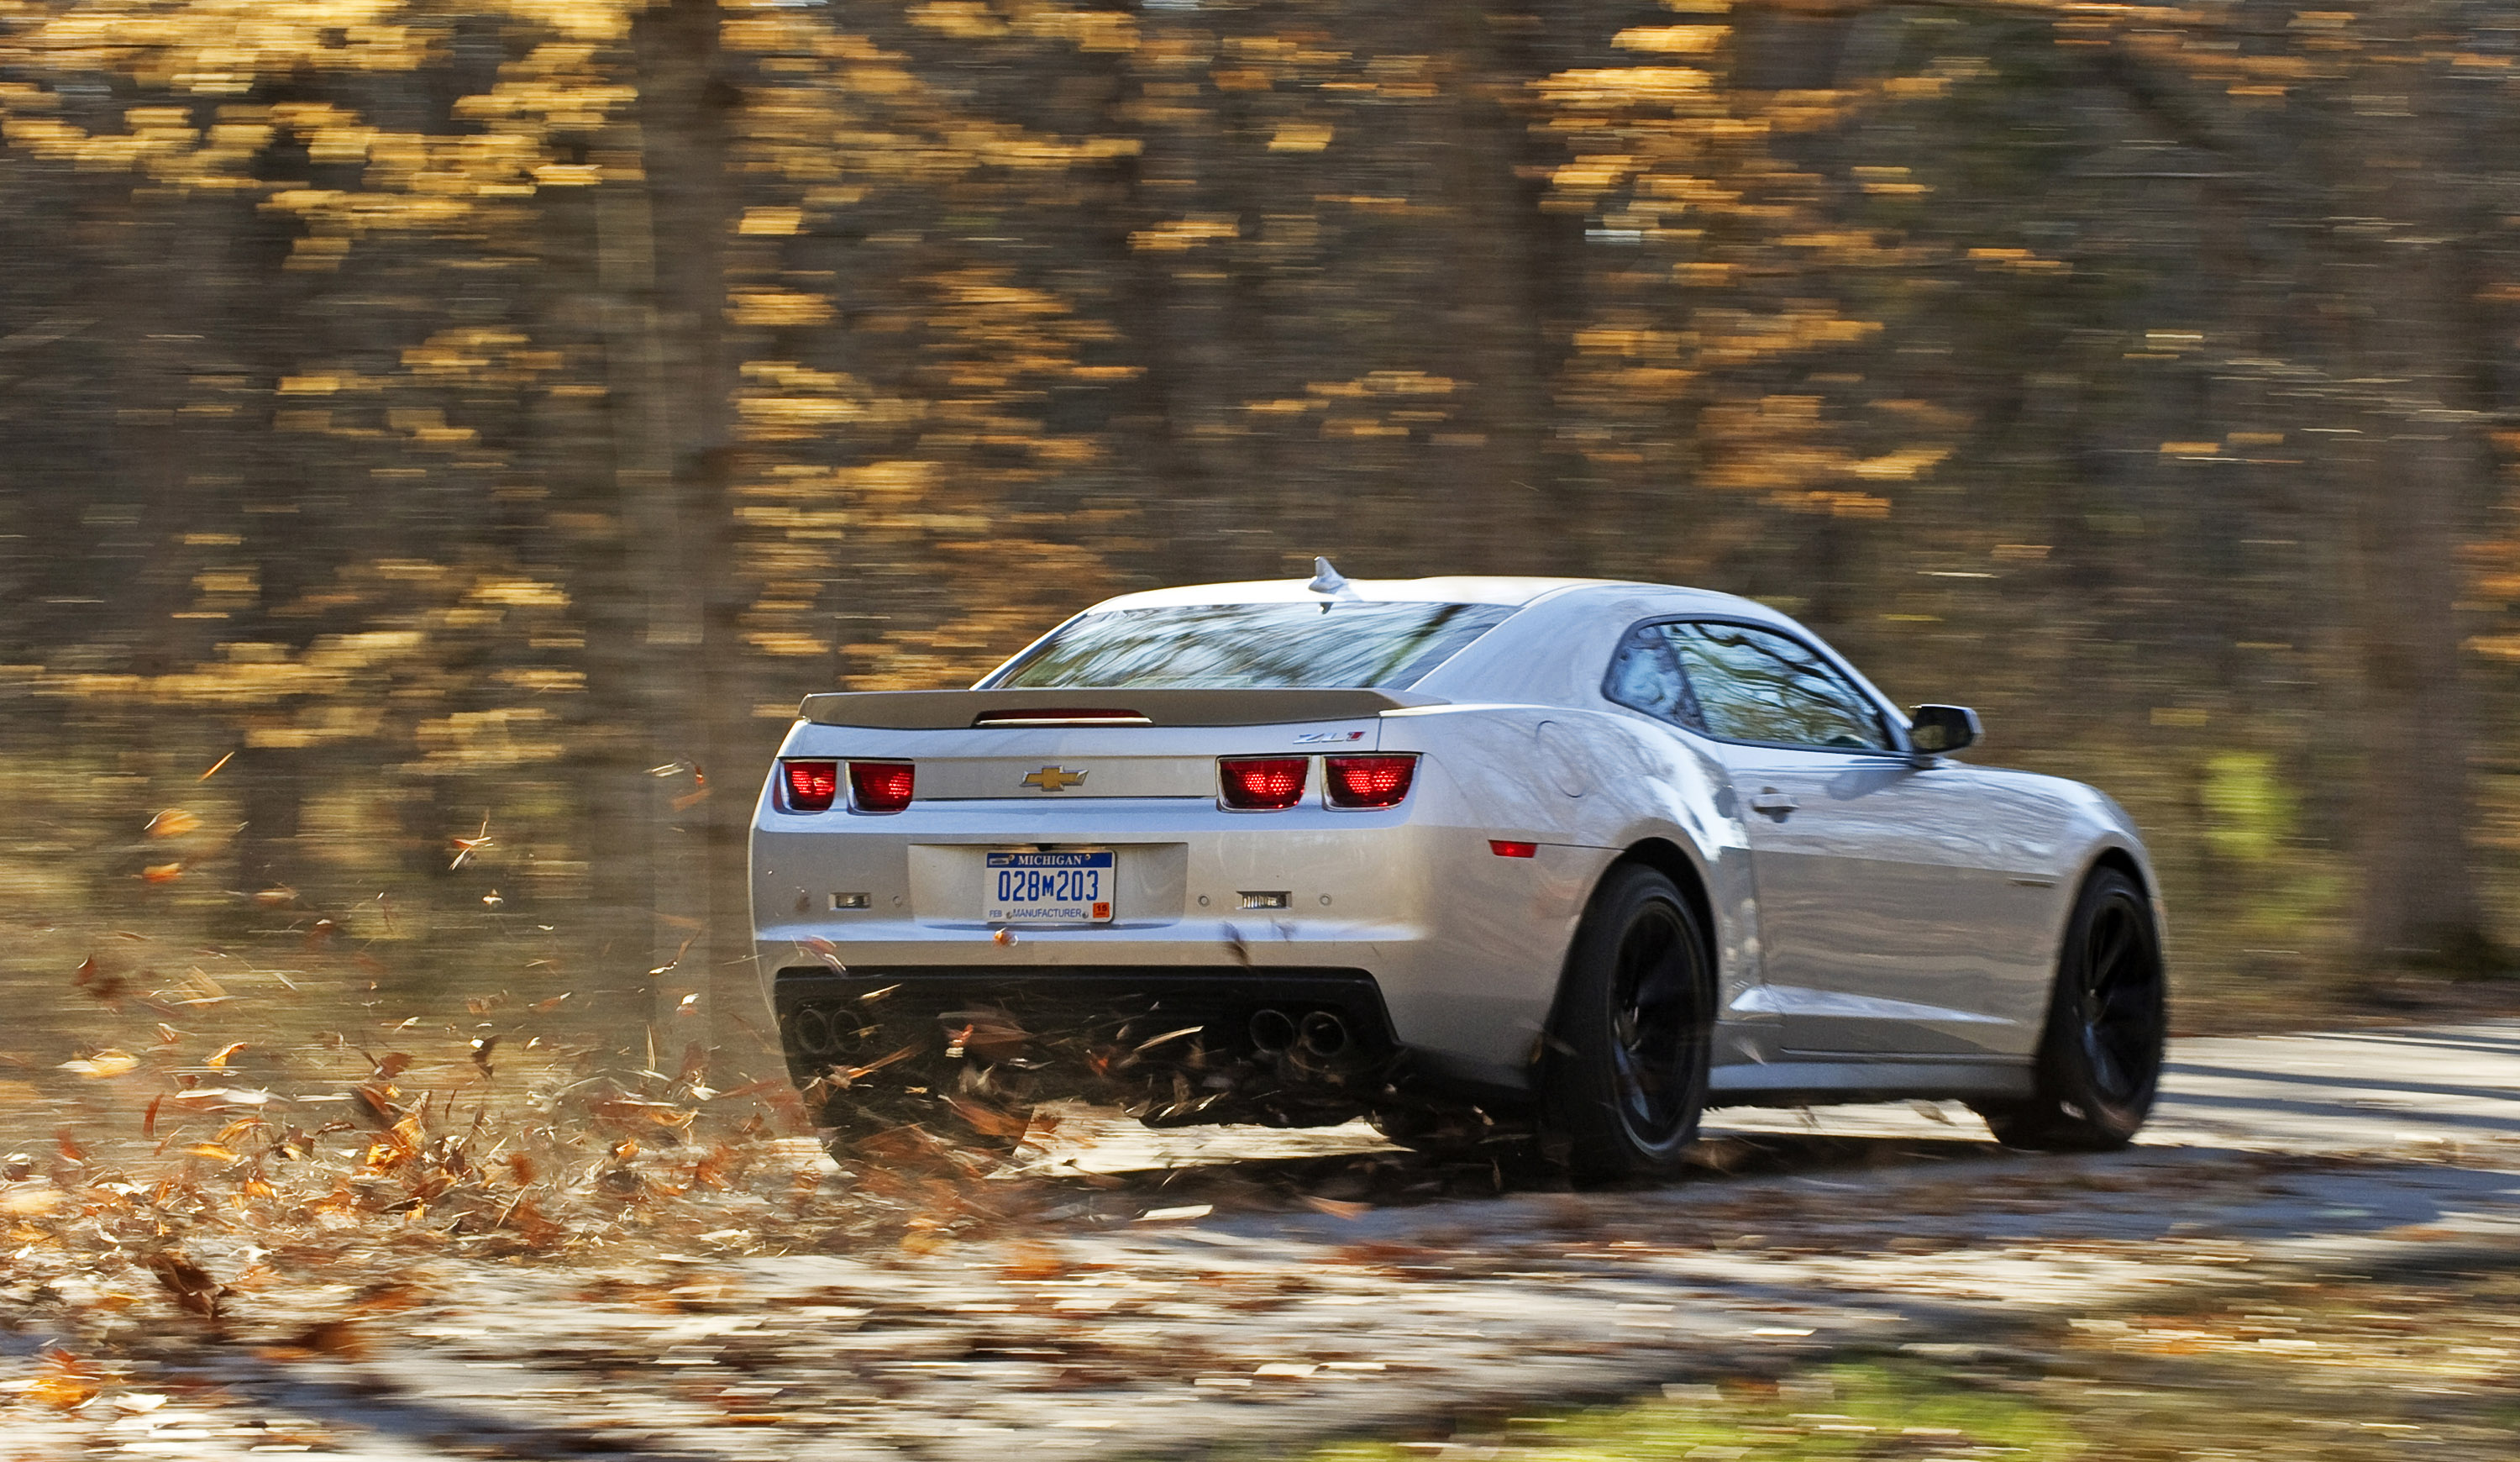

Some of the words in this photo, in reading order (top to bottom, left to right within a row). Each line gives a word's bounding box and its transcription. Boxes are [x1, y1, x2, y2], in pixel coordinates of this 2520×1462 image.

[1018, 855, 1082, 865] MICHIGAN
[998, 870, 1099, 902] 028M203
[1013, 908, 1082, 918] MANUFACTURER
